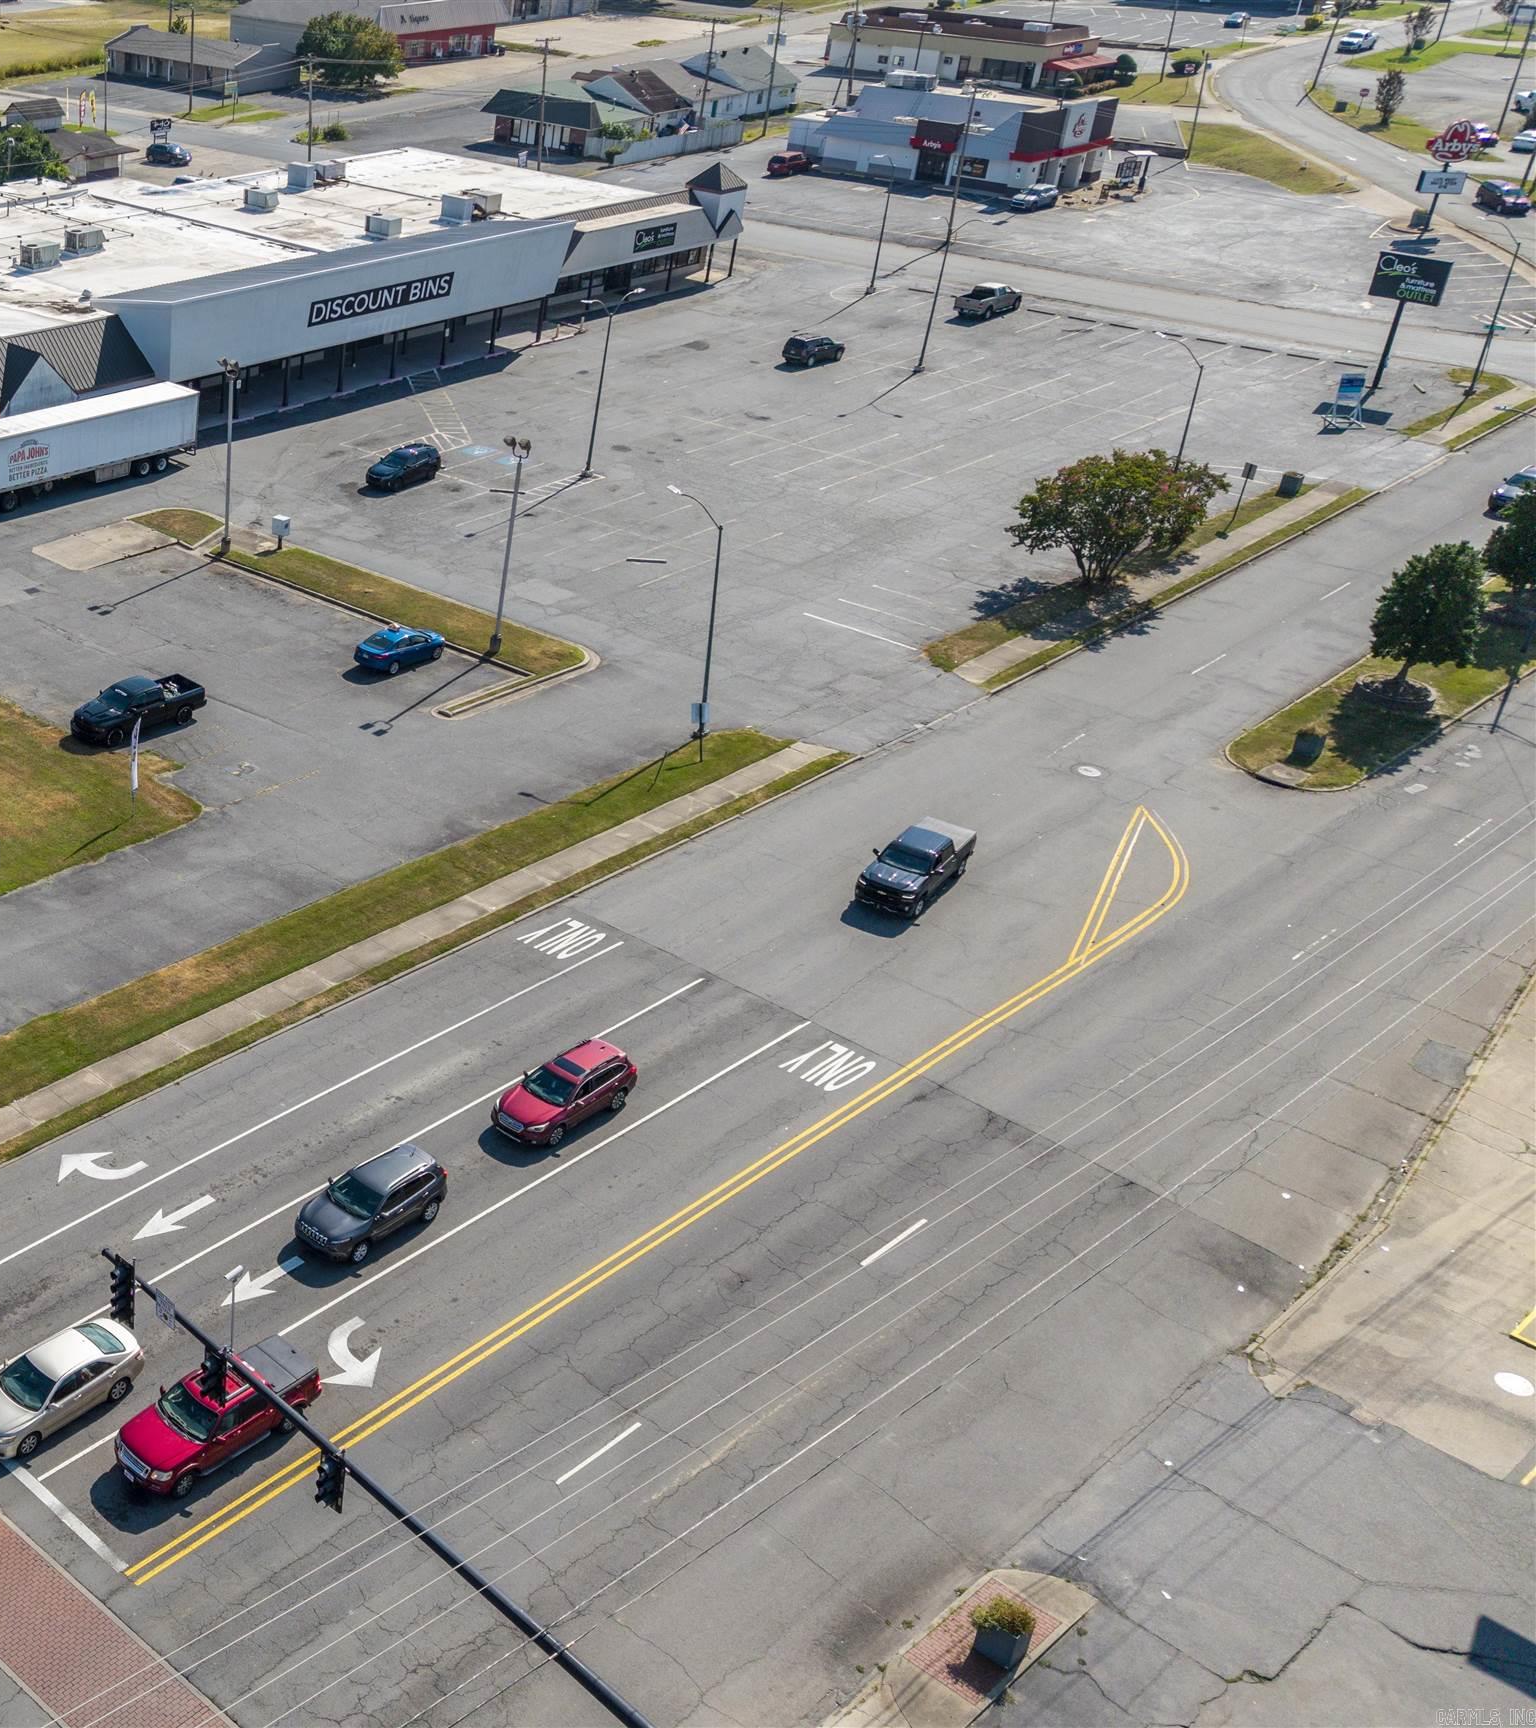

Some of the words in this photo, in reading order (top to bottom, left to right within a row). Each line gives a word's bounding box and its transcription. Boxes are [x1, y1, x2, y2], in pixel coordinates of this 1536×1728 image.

[1431, 138, 1481, 156] Arby's
[1379, 255, 1419, 274] Cleo's
[1404, 276, 1436, 288] furniture
[311, 284, 407, 323] DISCOUNT
[408, 275, 451, 301] BINS
[1396, 289, 1436, 303] OUTLET
[9, 449, 26, 464] PAPA
[8, 470, 31, 482] BETTER
[31, 465, 48, 478] PIZZA
[516, 917, 607, 960] ONLY
[778, 1040, 877, 1092] ONLY
